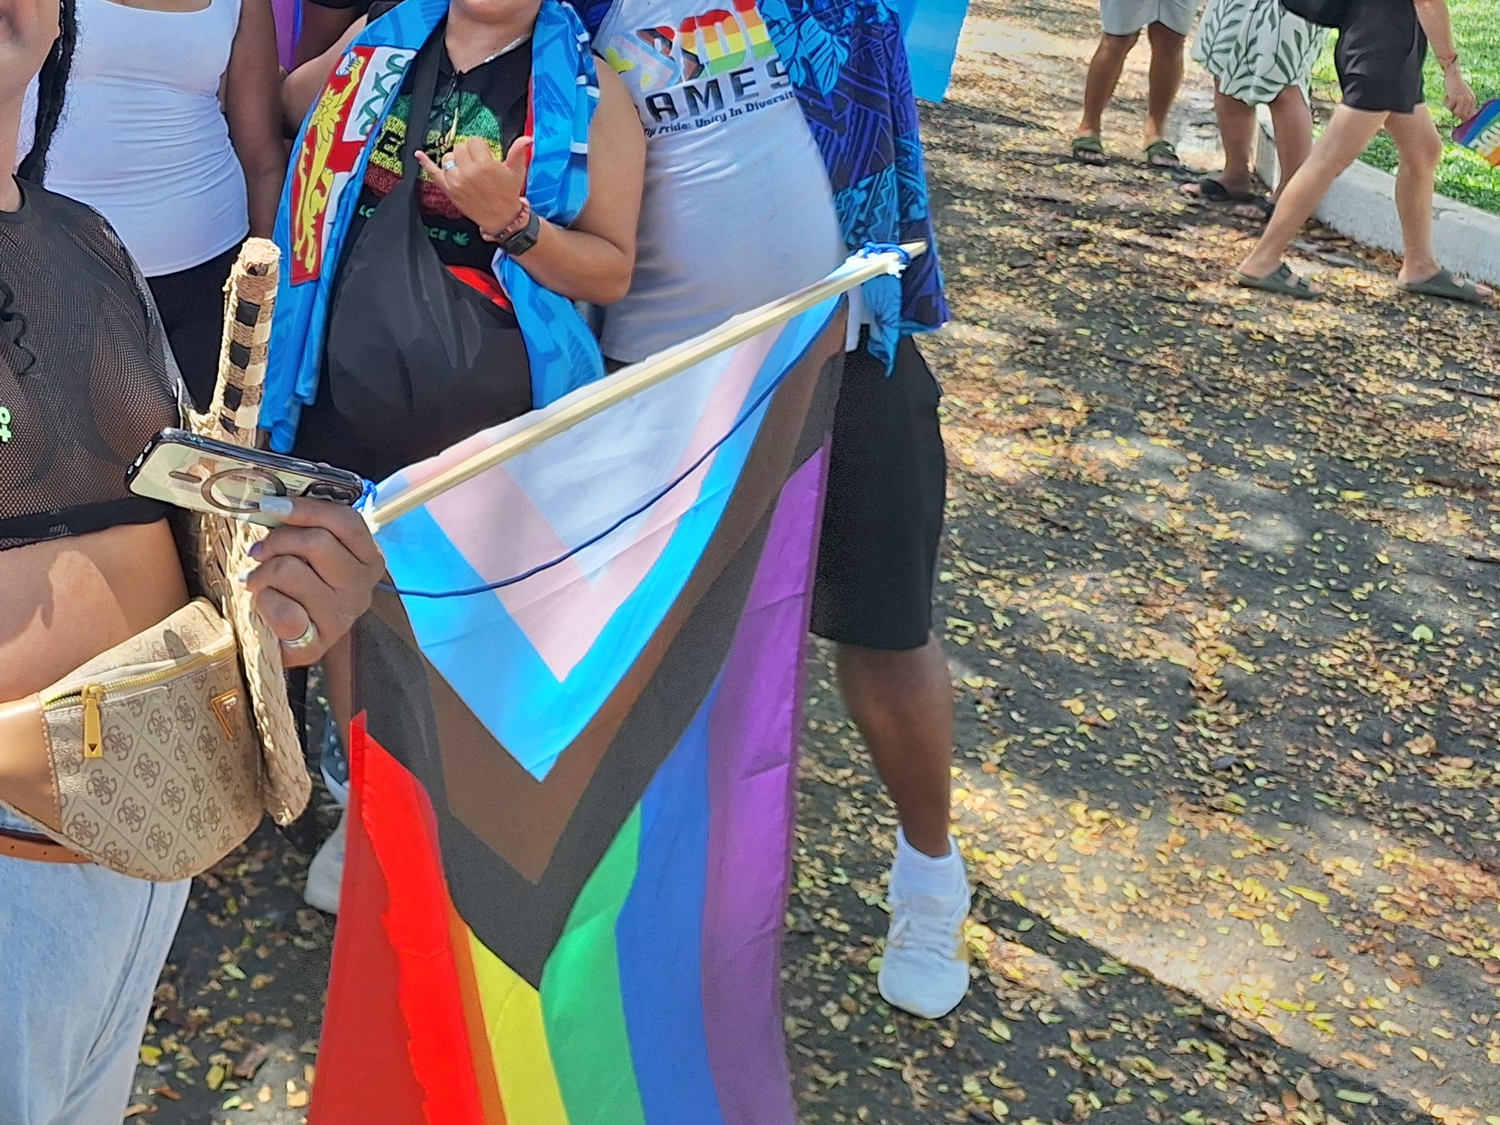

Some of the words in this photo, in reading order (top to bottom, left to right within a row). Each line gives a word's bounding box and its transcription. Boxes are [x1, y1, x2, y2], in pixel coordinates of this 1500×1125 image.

[643, 57, 790, 124] AMES
[729, 107, 742, 117] In
[745, 90, 794, 113] Diversit
